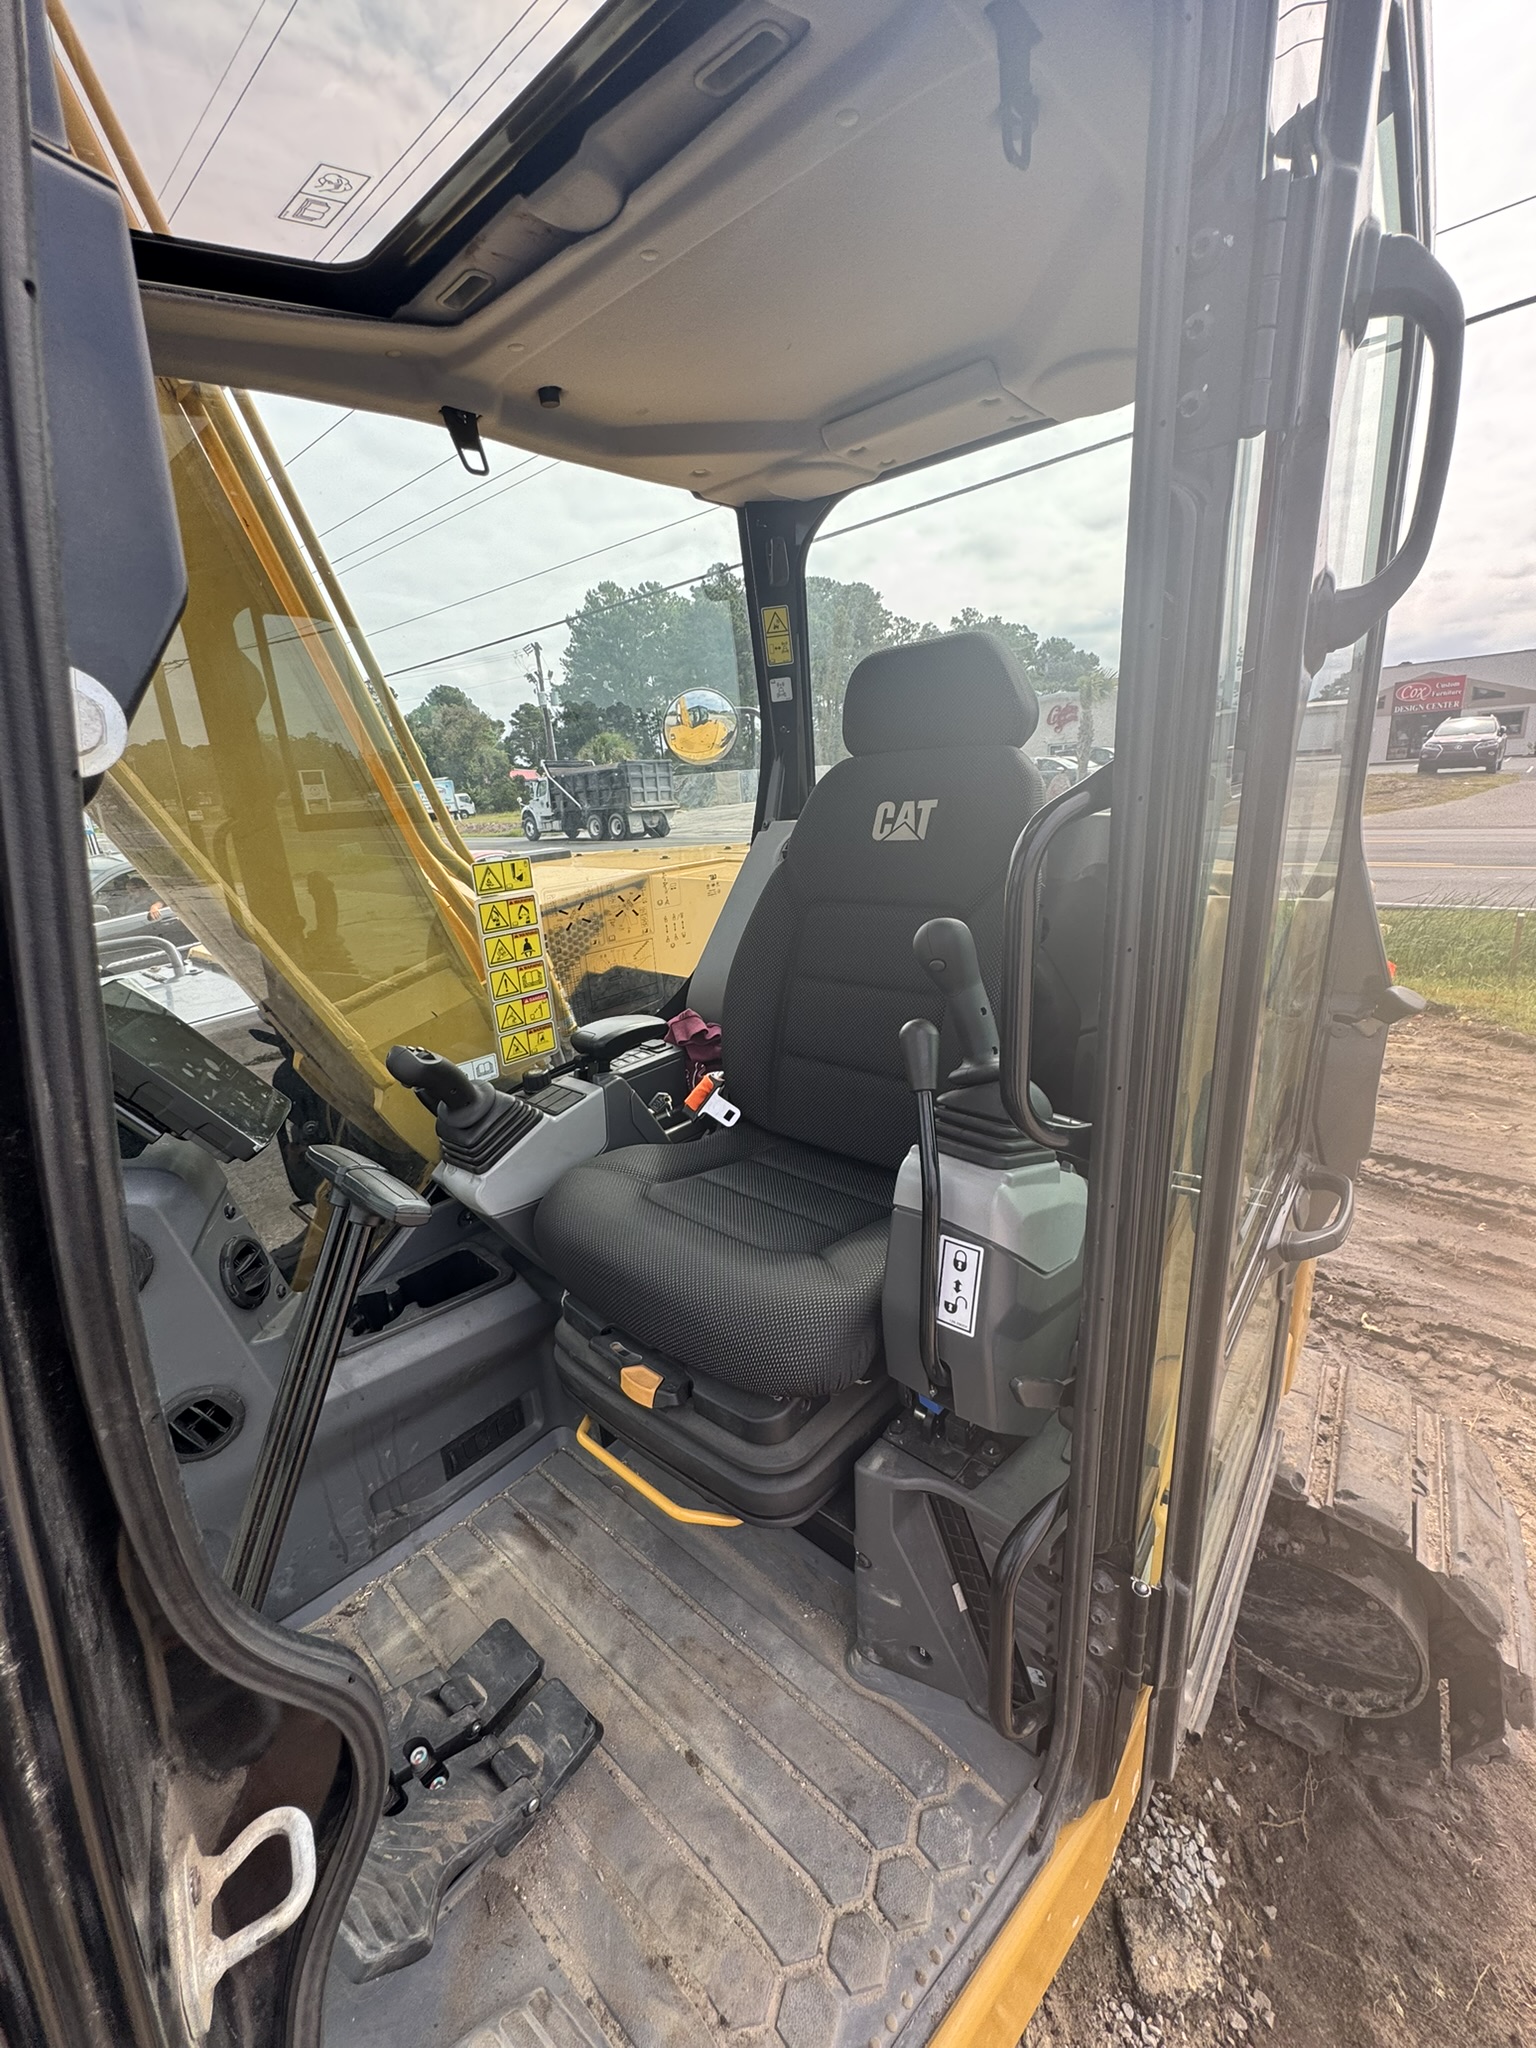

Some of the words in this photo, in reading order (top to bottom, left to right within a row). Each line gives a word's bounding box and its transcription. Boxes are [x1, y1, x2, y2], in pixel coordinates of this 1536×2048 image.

[1401, 685, 1427, 700] Cox
[1394, 704, 1424, 713] DESIGN
[1425, 701, 1460, 710] CENTER
[872, 799, 939, 841] CAT
